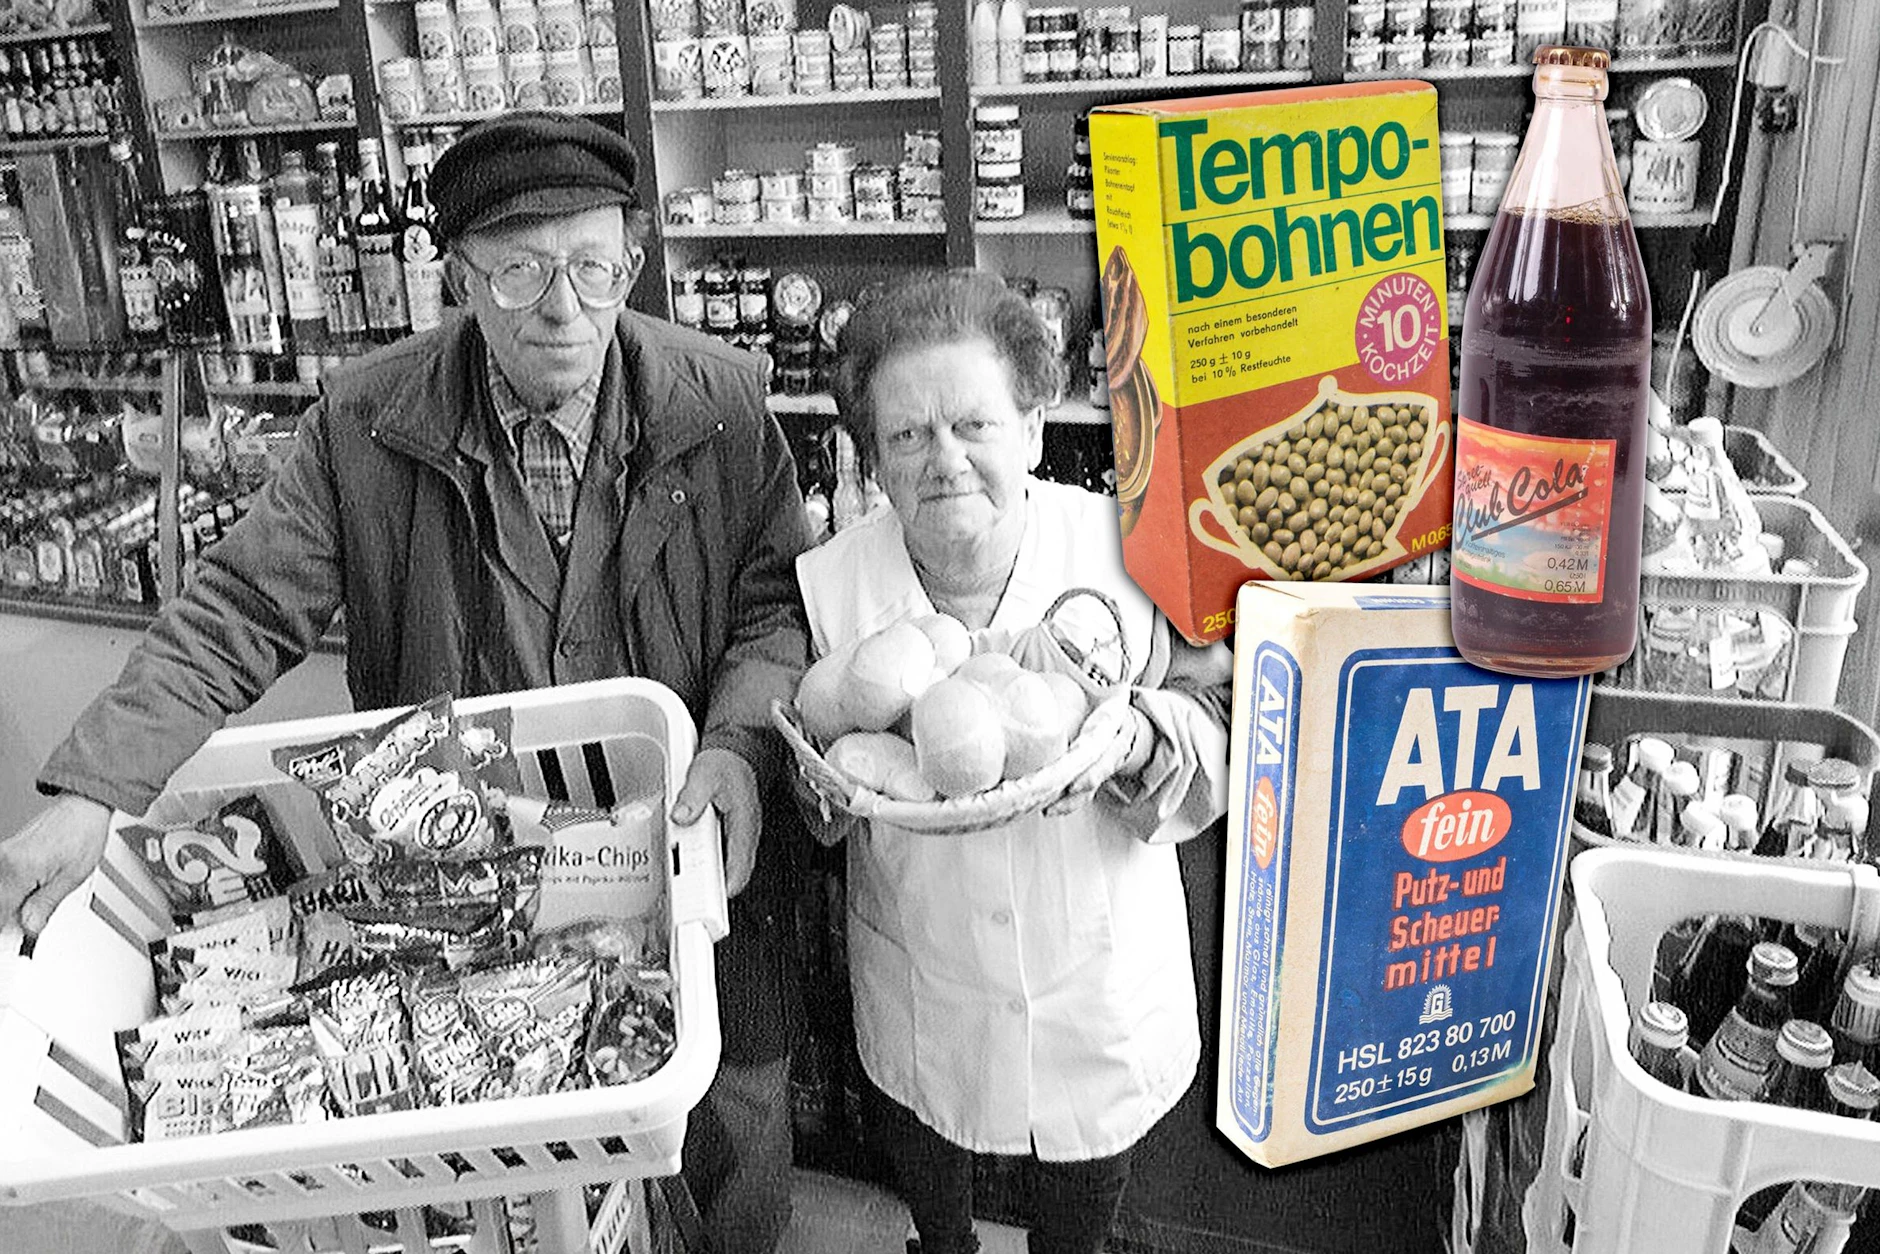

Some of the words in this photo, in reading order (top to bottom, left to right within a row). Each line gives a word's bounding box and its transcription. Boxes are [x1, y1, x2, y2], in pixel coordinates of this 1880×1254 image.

[1158, 118, 1429, 211] Tempo-
[1171, 195, 1441, 303] bohnen
[1187, 321, 1210, 334] nach
[1214, 317, 1242, 329] einem
[1246, 306, 1297, 323] besonderen
[1360, 276, 1435, 328] MINUTEN
[1187, 333, 1235, 349] Verfahren
[1240, 318, 1298, 338] vorbehandelt
[1360, 323, 1439, 381] KOCHZEIT
[1377, 304, 1421, 353] 10
[1190, 357, 1207, 369] 250
[1231, 350, 1243, 360] 10
[1191, 372, 1207, 383] bei
[1240, 354, 1291, 373] Restfeuchte
[1455, 481, 1505, 551] Club
[1507, 458, 1584, 517] Cola
[1256, 675, 1285, 765] ATA
[1375, 684, 1541, 807] ATA
[1253, 788, 1274, 858] fein
[1417, 798, 1496, 857] fein
[1263, 883, 1274, 923] reinigt
[1392, 867, 1460, 911] Putz-
[1462, 857, 1507, 897] und
[1243, 941, 1252, 988] Marmor
[1262, 925, 1272, 966] schnell
[1384, 936, 1497, 991] mittel
[1260, 968, 1268, 992] und
[1238, 1016, 1247, 1052] Metall
[1256, 993, 1266, 1047] gründlich
[1337, 1042, 1392, 1074] HSL
[1397, 1029, 1440, 1060] 823
[1445, 1021, 1473, 1047] 80
[1479, 1010, 1516, 1039] 700
[1237, 1052, 1245, 1082] jeder
[1254, 1050, 1262, 1072] alle
[1334, 1076, 1375, 1105] 250
